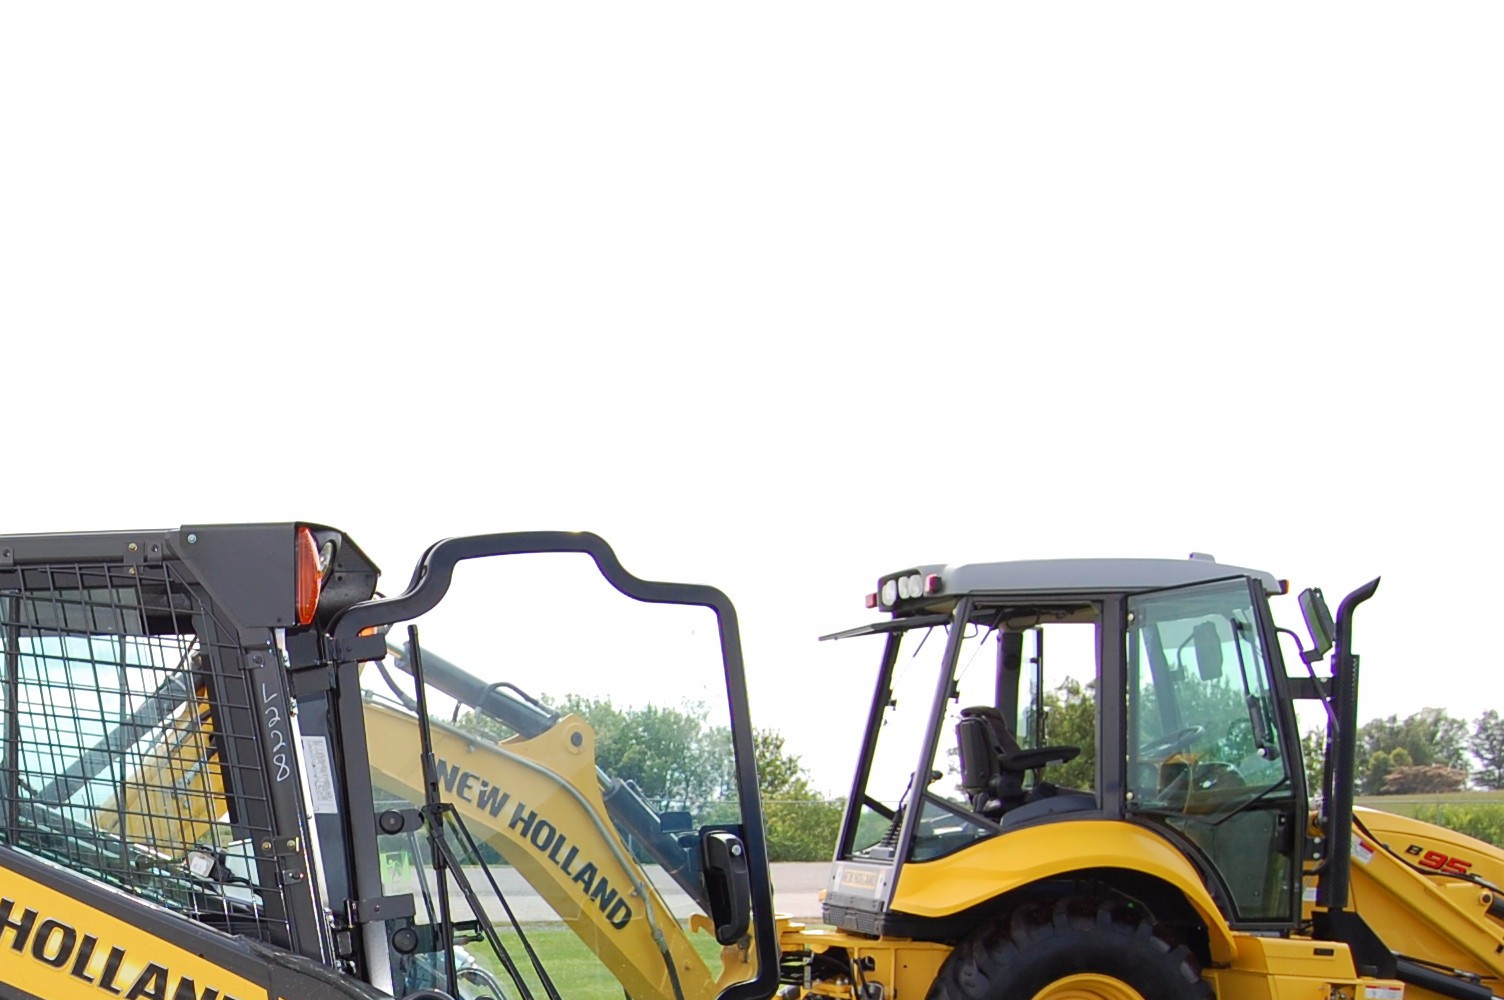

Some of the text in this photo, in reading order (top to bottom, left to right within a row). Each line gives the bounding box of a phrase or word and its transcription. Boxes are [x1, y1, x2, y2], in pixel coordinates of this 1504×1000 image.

[262, 683, 290, 782] L228
[436, 759, 510, 818] NEW
[508, 802, 633, 930] HOLLAND
